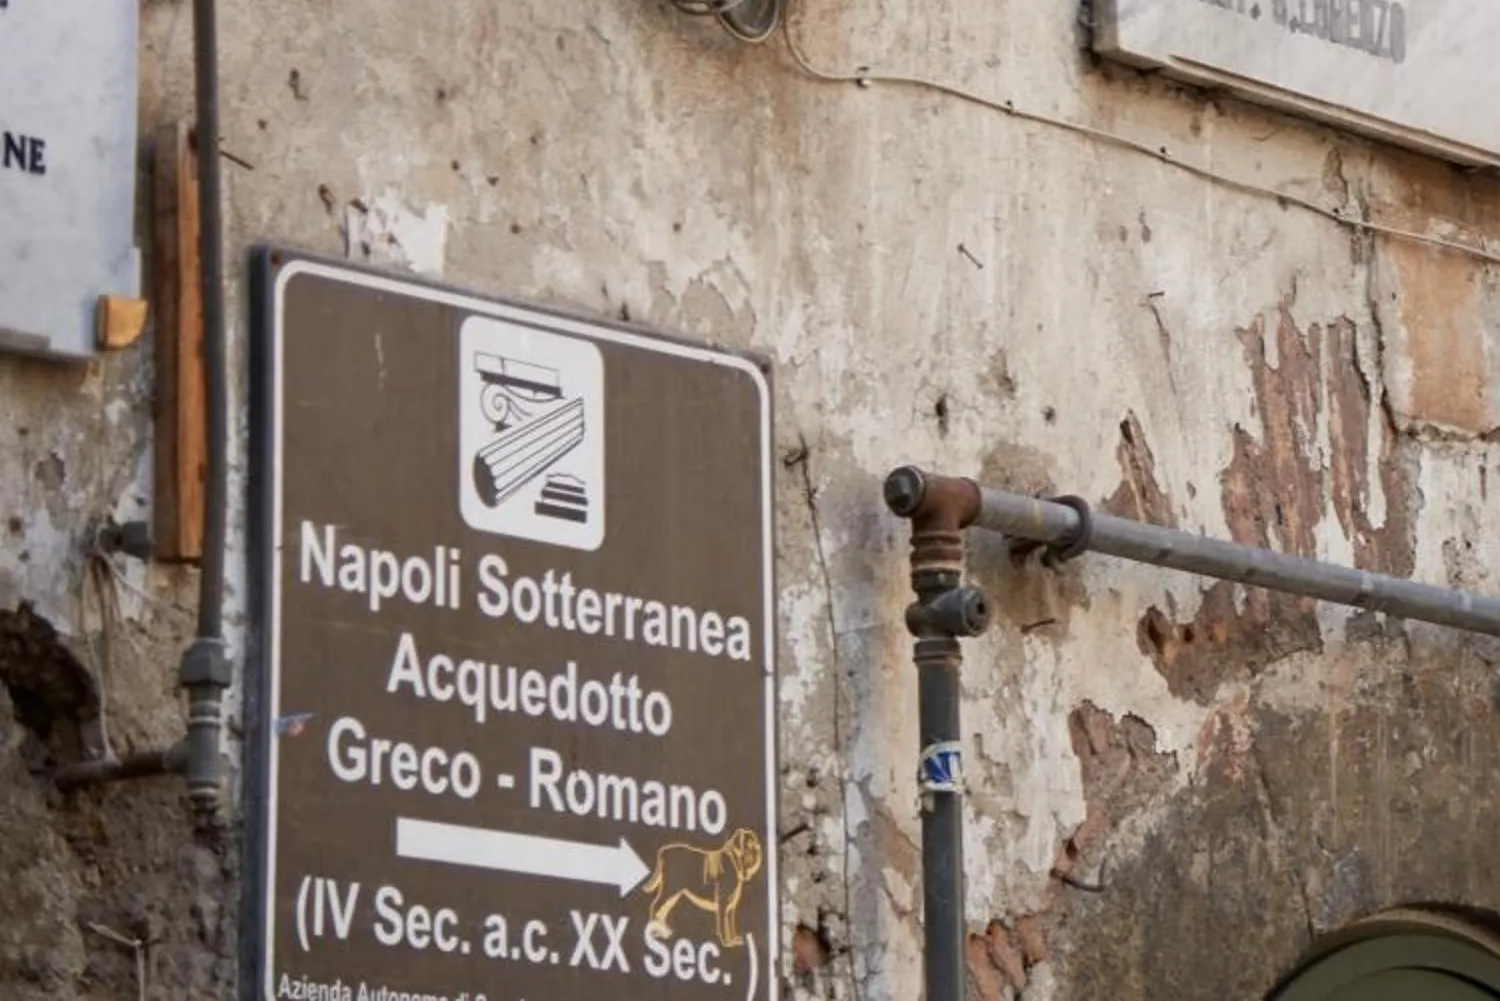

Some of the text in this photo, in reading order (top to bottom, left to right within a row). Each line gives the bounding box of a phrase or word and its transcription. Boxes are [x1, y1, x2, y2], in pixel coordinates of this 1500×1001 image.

[300, 520, 751, 662] Napoli Sotterranea
[387, 632, 673, 737] Acquedotto
[327, 716, 482, 799] Greco
[530, 746, 727, 835] Romano
[297, 875, 360, 952] (IV
[374, 885, 472, 955] Sec.
[483, 911, 560, 965] a.c.
[569, 910, 631, 974] XX
